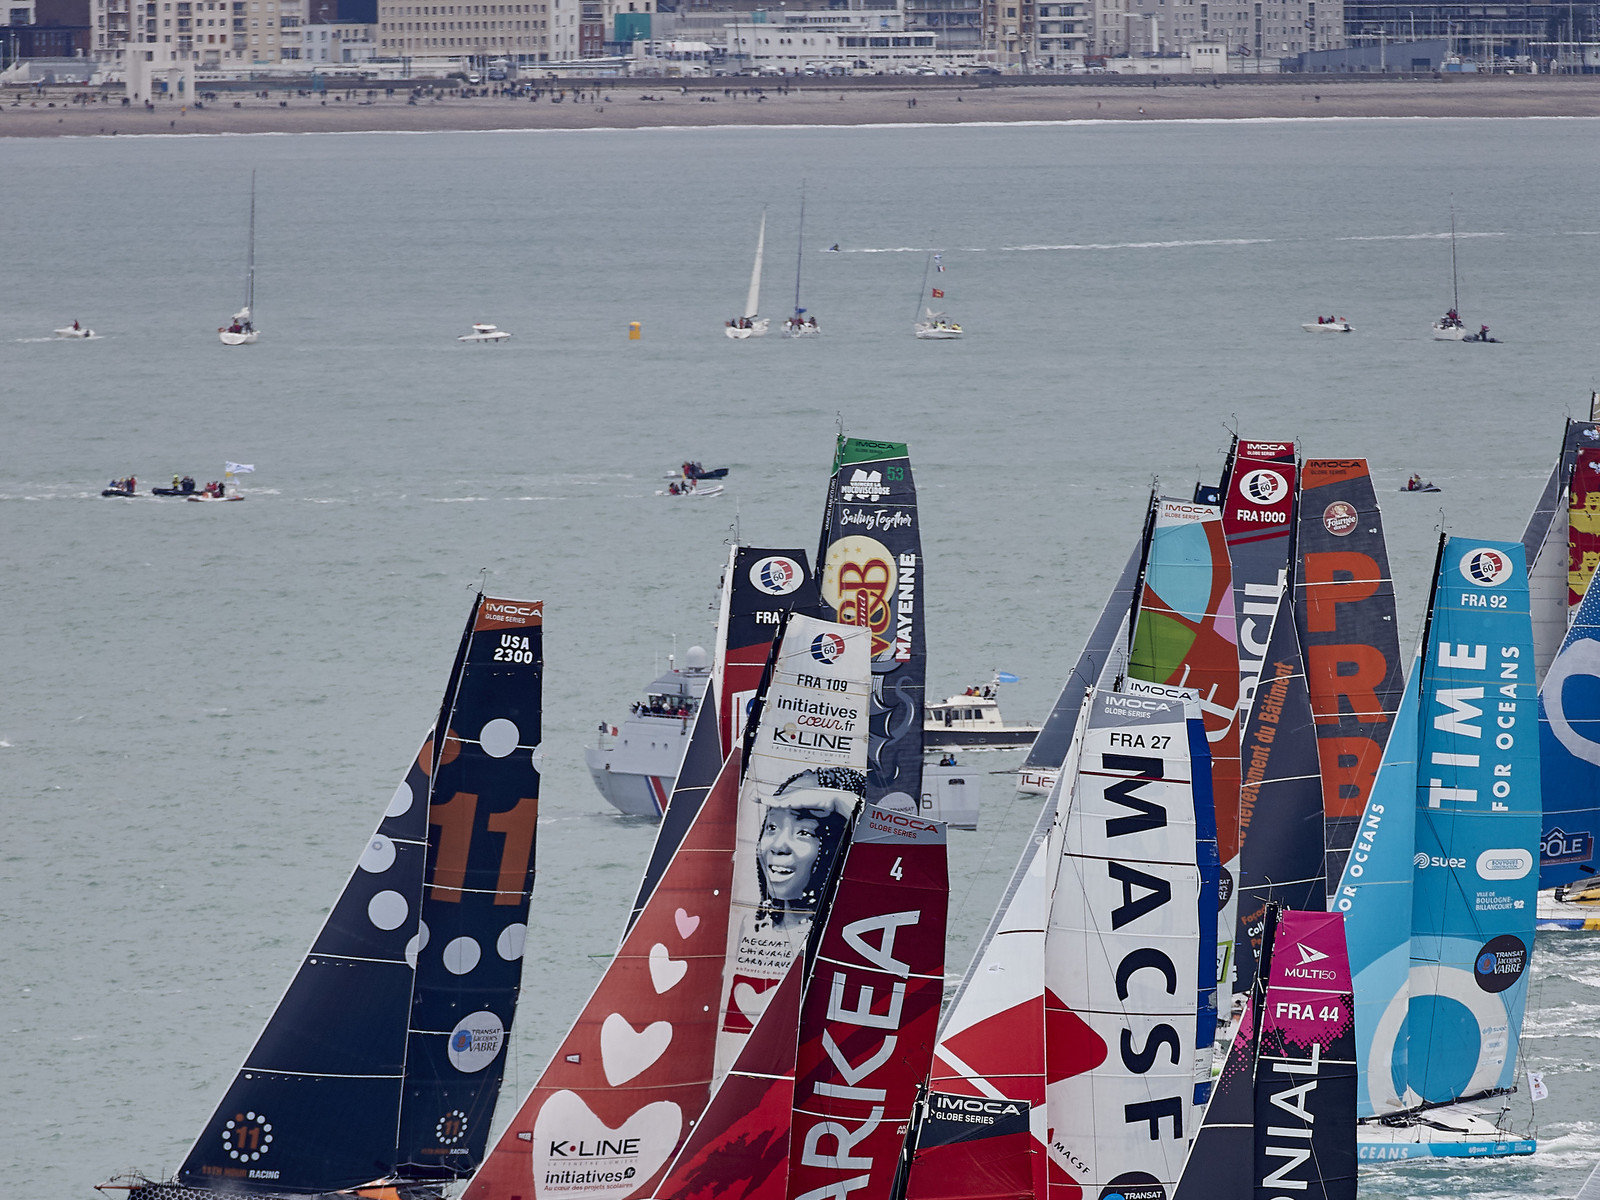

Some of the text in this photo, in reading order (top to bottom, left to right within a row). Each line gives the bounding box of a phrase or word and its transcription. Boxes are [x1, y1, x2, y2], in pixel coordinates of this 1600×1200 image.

[856, 441, 895, 450] IMOCA
[1247, 443, 1287, 451] IMOCA
[887, 466, 904, 481] 53
[841, 486, 890, 495] MUCOVISCIDOSE
[1260, 484, 1270, 493] 60
[1165, 504, 1214, 515] IMOCA
[1237, 510, 1286, 523] FRA 1000
[841, 508, 912, 531] Sailing Together
[1482, 563, 1494, 573] 60
[773, 572, 784, 582] 60
[895, 553, 915, 660] MAYENNE
[1461, 594, 1507, 608] FRA 92
[486, 603, 542, 617] IMOCA
[756, 611, 780, 624] FRA
[505, 616, 525, 624] SERIES
[501, 634, 529, 650] USA
[494, 648, 533, 664] 2300
[824, 646, 835, 654] 60
[797, 674, 848, 692] FRA 109
[1304, 552, 1388, 817] PRB
[1130, 683, 1193, 700] IMOCA
[778, 695, 857, 720] initiatives
[1105, 696, 1171, 712] IMOCA
[1254, 662, 1294, 744] du Bâtiment
[1105, 707, 1151, 719] GLOBE SERIES
[1428, 642, 1487, 808] TIME
[1492, 646, 1519, 811] FOR OCEANS
[1110, 733, 1171, 750] FRA 27
[872, 810, 939, 833] IMOCA
[870, 822, 917, 839] GLOBE SERIES
[430, 792, 539, 906] 11
[1338, 803, 1385, 912] OR OCEANS
[1431, 857, 1466, 868] suez
[890, 857, 903, 881] 4
[1102, 753, 1183, 1140] MACSF
[1495, 950, 1524, 958] TRANSAT
[1285, 968, 1336, 980] MULTI50
[1494, 964, 1520, 974] VABRE
[1276, 1003, 1339, 1022] FRA 44
[469, 1042, 498, 1052] VABRE
[937, 1097, 1021, 1115] IMOCA
[936, 1111, 994, 1125] GLOBE SERIES
[236, 1126, 260, 1149] 11
[1053, 1140, 1091, 1174] MACSF
[1359, 1146, 1408, 1160] CEANS
[248, 1169, 280, 1179] RACING
[545, 1171, 622, 1184] initiatives
